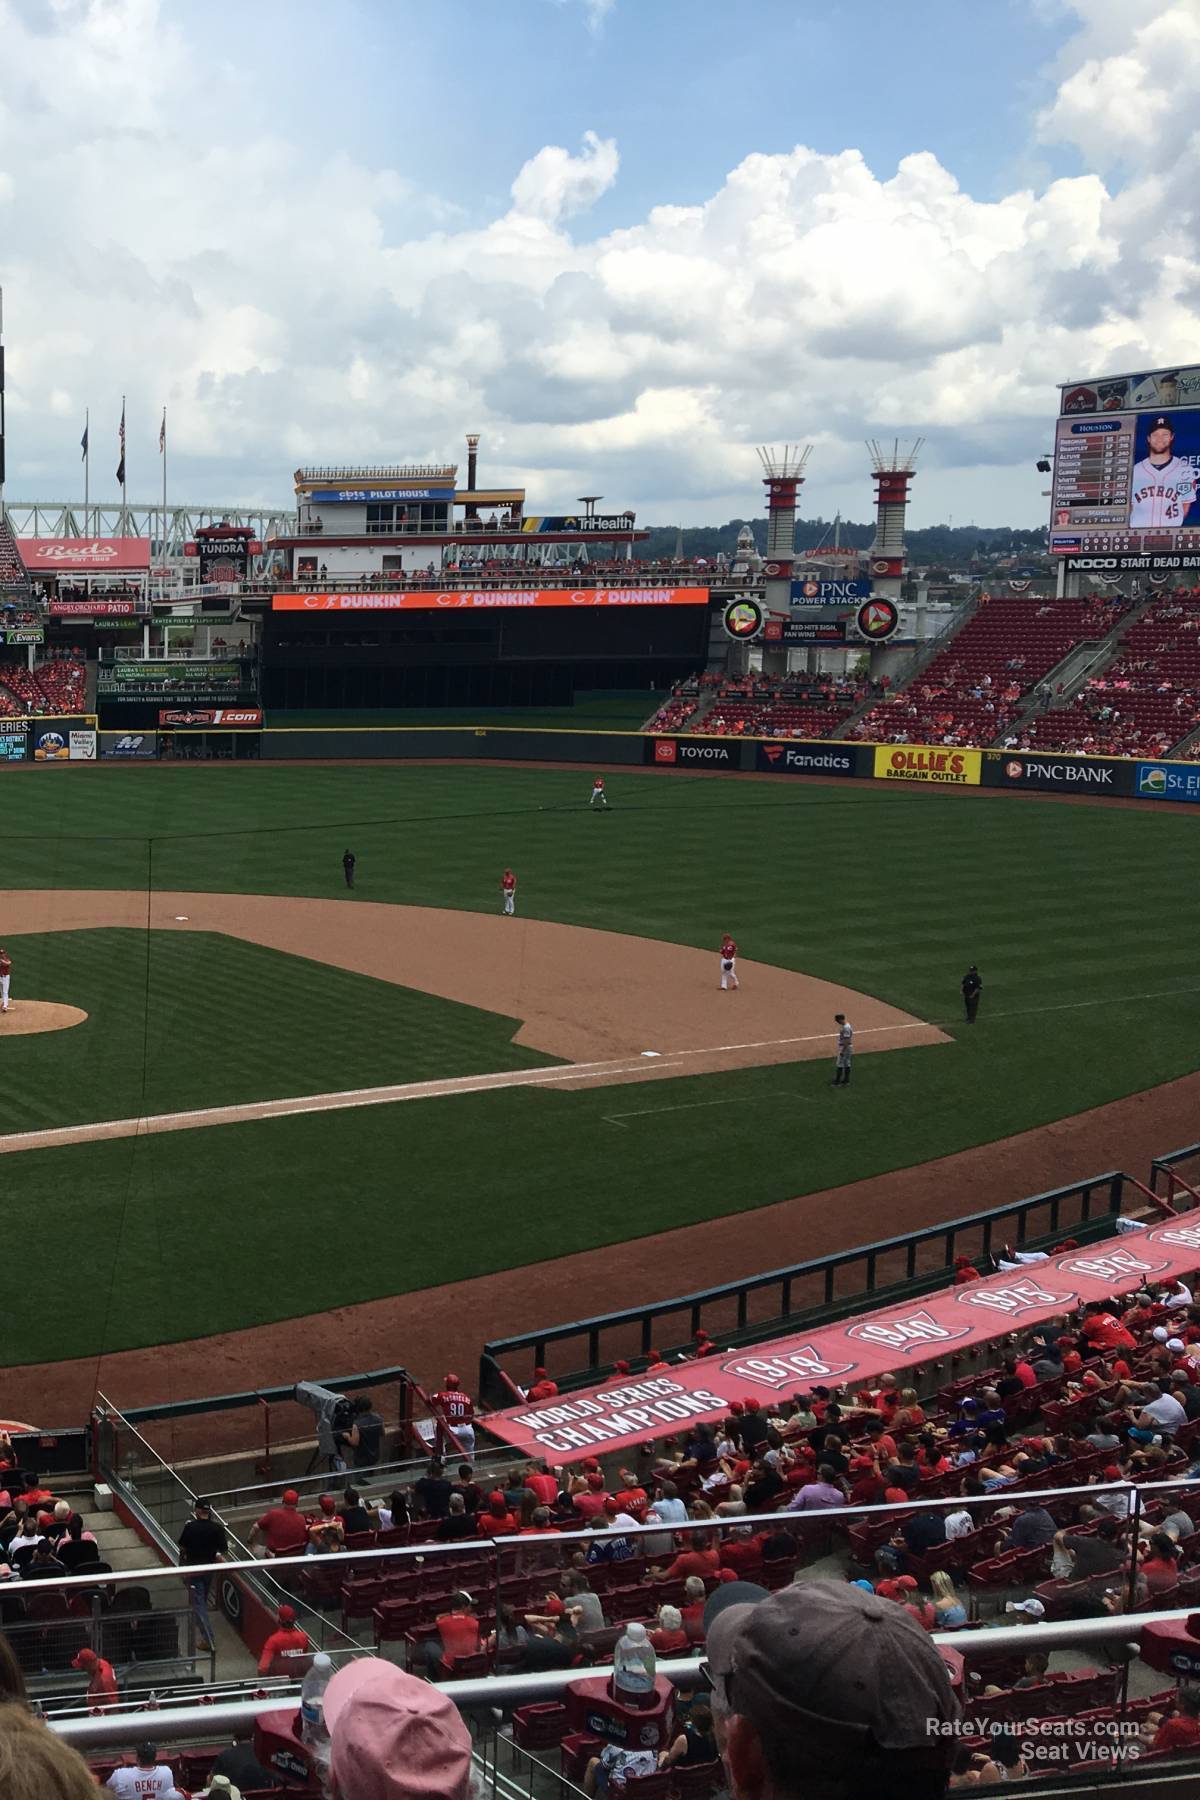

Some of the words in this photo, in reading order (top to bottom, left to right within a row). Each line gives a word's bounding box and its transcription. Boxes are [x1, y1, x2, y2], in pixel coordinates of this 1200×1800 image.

[1080, 424, 1113, 432] HOUSTON
[370, 490, 397, 498] PILOT
[399, 489, 430, 497] HOUSE
[1135, 487, 1179, 504] ASTROS
[1165, 504, 1179, 519] 45
[578, 517, 632, 530] TriHealth
[35, 543, 118, 560] Reds
[201, 544, 244, 553] TUNDRA
[1068, 558, 1117, 569] NOCO
[1121, 558, 1151, 568] START
[1153, 557, 1180, 567] DEAD
[608, 590, 676, 604] DUNKIN'
[821, 582, 857, 597] PNC
[341, 594, 405, 608] DUNKIN'
[474, 592, 539, 606] DUNKIN'
[792, 597, 826, 605] POWER
[107, 604, 130, 613] PATIO
[17, 634, 41, 642] Evans
[73, 739, 94, 747] Valley
[680, 747, 729, 759] TOYOTA
[786, 751, 850, 769] Fanatics
[886, 769, 928, 779] BARGAIN
[931, 772, 967, 782] OUTLET
[1026, 763, 1064, 780] PNC
[1065, 767, 1113, 784] BANK
[1168, 774, 1185, 789] St.
[1071, 1254, 1146, 1279] 1976
[969, 1285, 1058, 1311] 1975
[859, 1319, 942, 1347] 1940
[735, 1352, 831, 1382] 1919
[449, 1402, 465, 1417] 90
[512, 1398, 605, 1430] WORLD
[596, 1378, 685, 1408] SERIES
[535, 1390, 729, 1451] CHAMPIONS
[134, 1778, 163, 1793] BENCH
